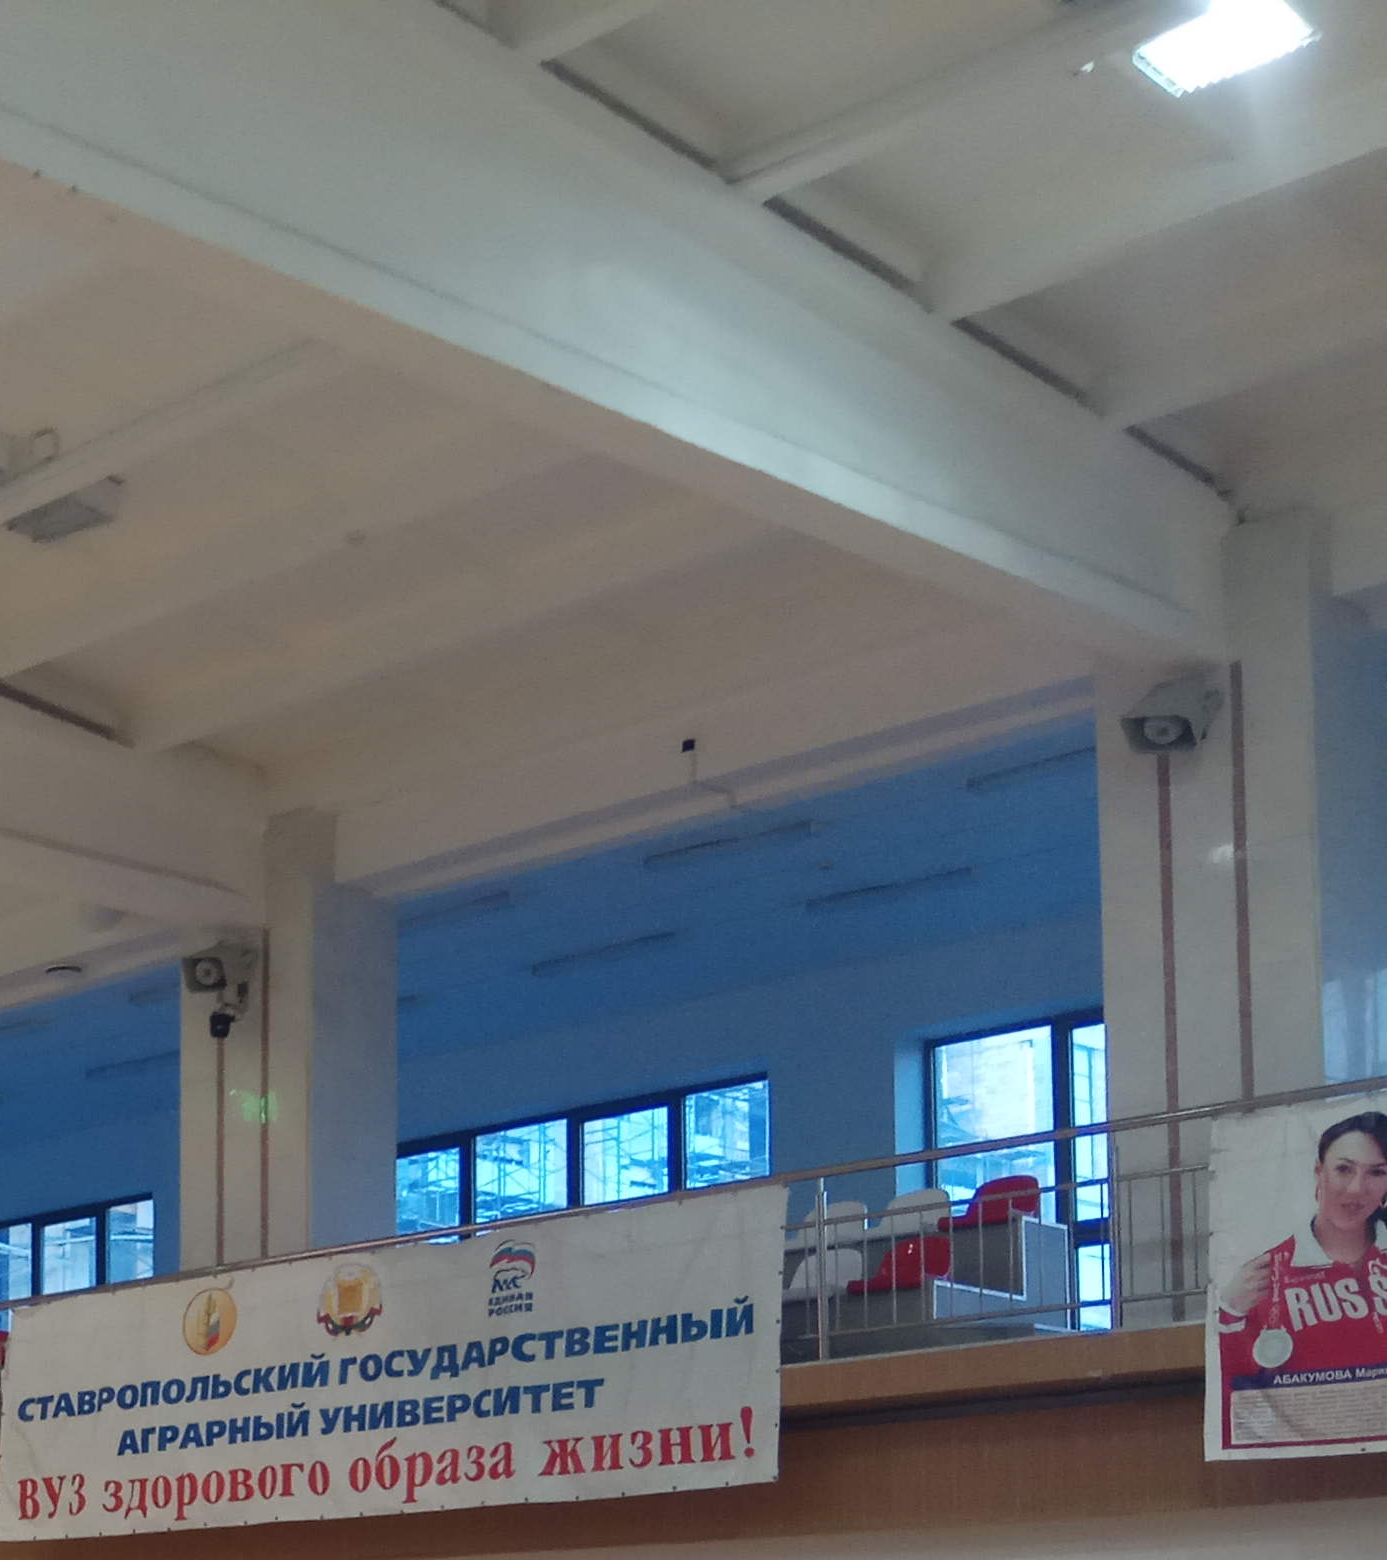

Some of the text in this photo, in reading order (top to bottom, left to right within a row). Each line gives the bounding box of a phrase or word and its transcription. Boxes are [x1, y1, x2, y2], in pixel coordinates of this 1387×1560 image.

[17, 1295, 755, 1423] СТАВРОПОЛЬСКИЙ ГОСУДАРСТВЕННЫЙ
[1273, 1368, 1352, 1385] АБАКУМОВА
[17, 1406, 756, 1521] ВУЗ здорового образа жизни!
[117, 1377, 605, 1456] АГРАРНЫЙ УНИВЕРСИТЕТ
